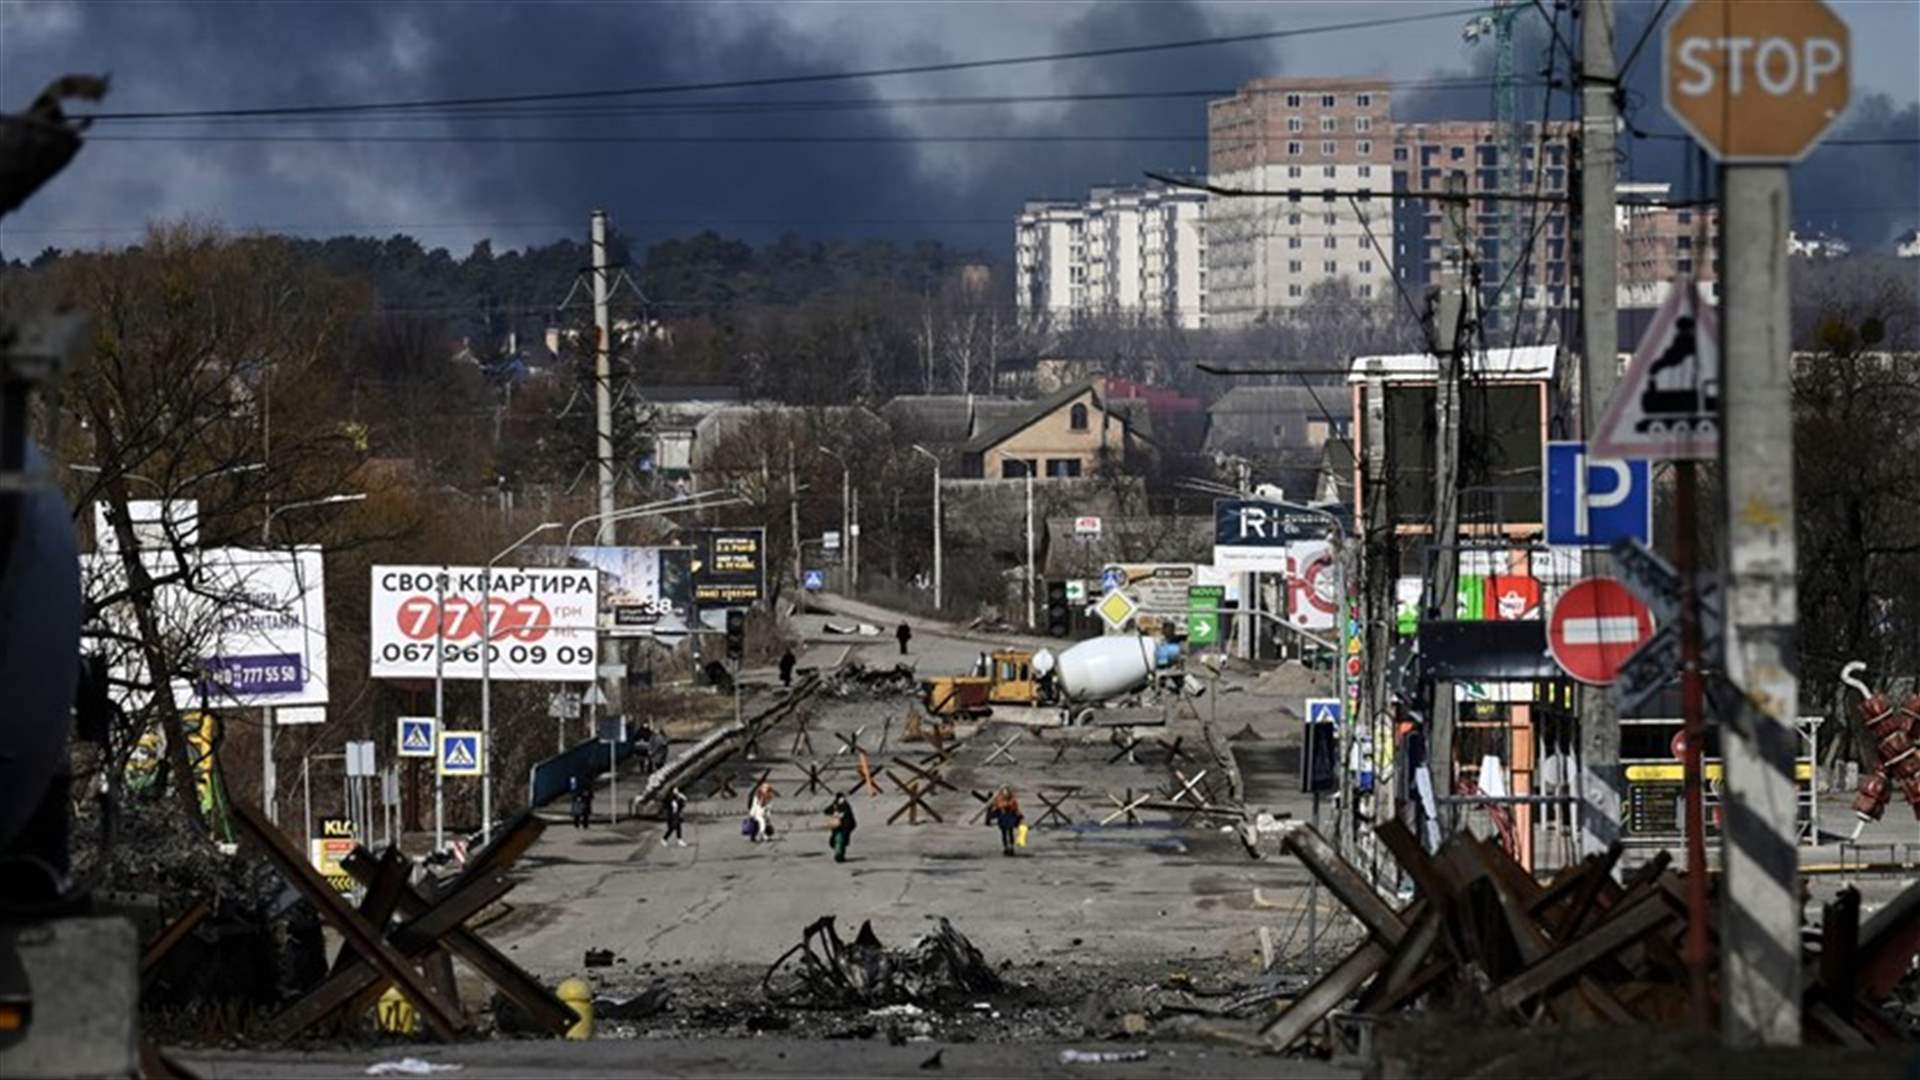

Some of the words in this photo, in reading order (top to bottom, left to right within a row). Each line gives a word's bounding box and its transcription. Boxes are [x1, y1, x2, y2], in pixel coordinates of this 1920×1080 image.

[1677, 37, 1842, 96] STOP
[1574, 453, 1632, 537] P
[382, 573, 449, 592] СВОЯ
[459, 574, 593, 594] КВАРТИРА
[644, 598, 672, 615] 38
[407, 603, 541, 636] 7777
[382, 643, 434, 662] 067
[444, 644, 500, 663] 960
[509, 645, 547, 664] 09
[557, 646, 593, 665] 09
[242, 667, 263, 683] 777
[265, 666, 280, 682] 55
[281, 665, 297, 682] 50
